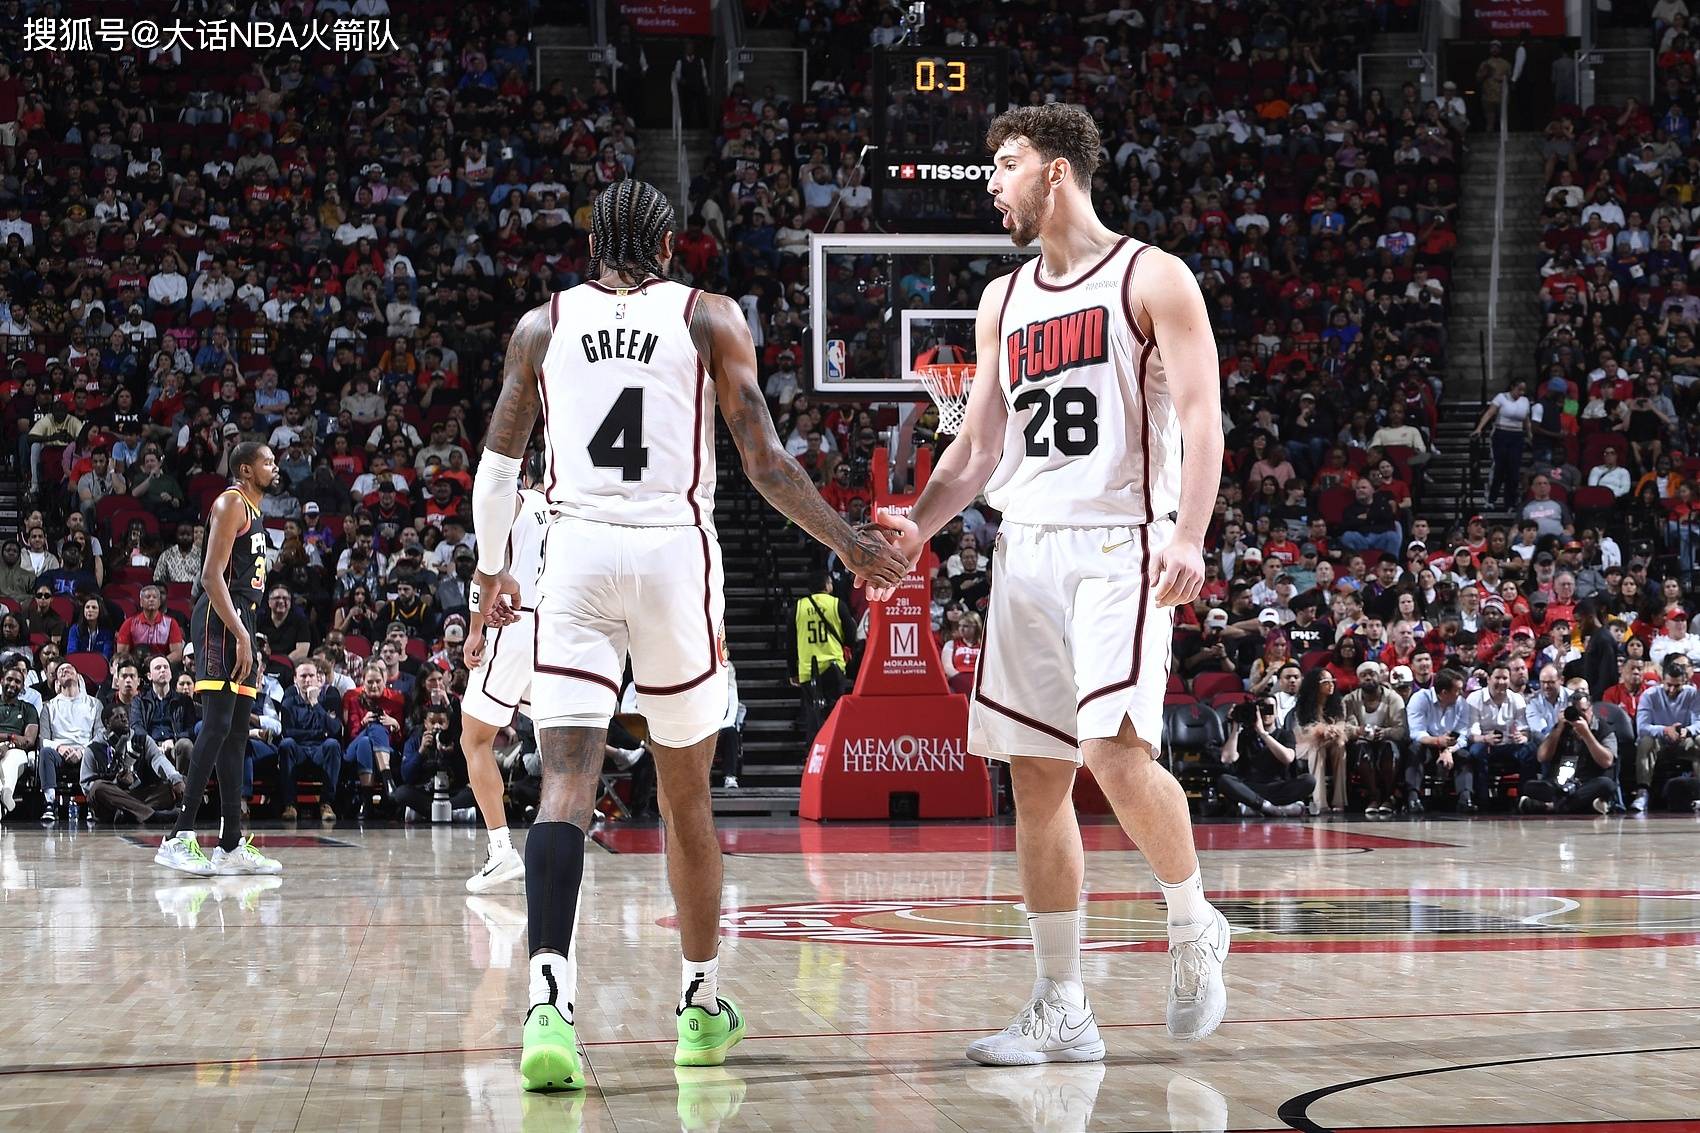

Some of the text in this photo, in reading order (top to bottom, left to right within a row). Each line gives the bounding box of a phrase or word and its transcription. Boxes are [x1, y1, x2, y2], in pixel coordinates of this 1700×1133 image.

[915, 61, 966, 92] 0.3
[916, 164, 996, 181] TISSOT
[581, 328, 659, 365] GREEN
[1013, 387, 1099, 456] 28
[586, 386, 649, 482] 4
[472, 592, 480, 605] 9
[885, 606, 922, 616] 222-2222
[807, 621, 828, 644] 50
[1290, 630, 1321, 640] PHX
[843, 735, 966, 757] MEMORIAL
[843, 754, 964, 773] HERMANN
